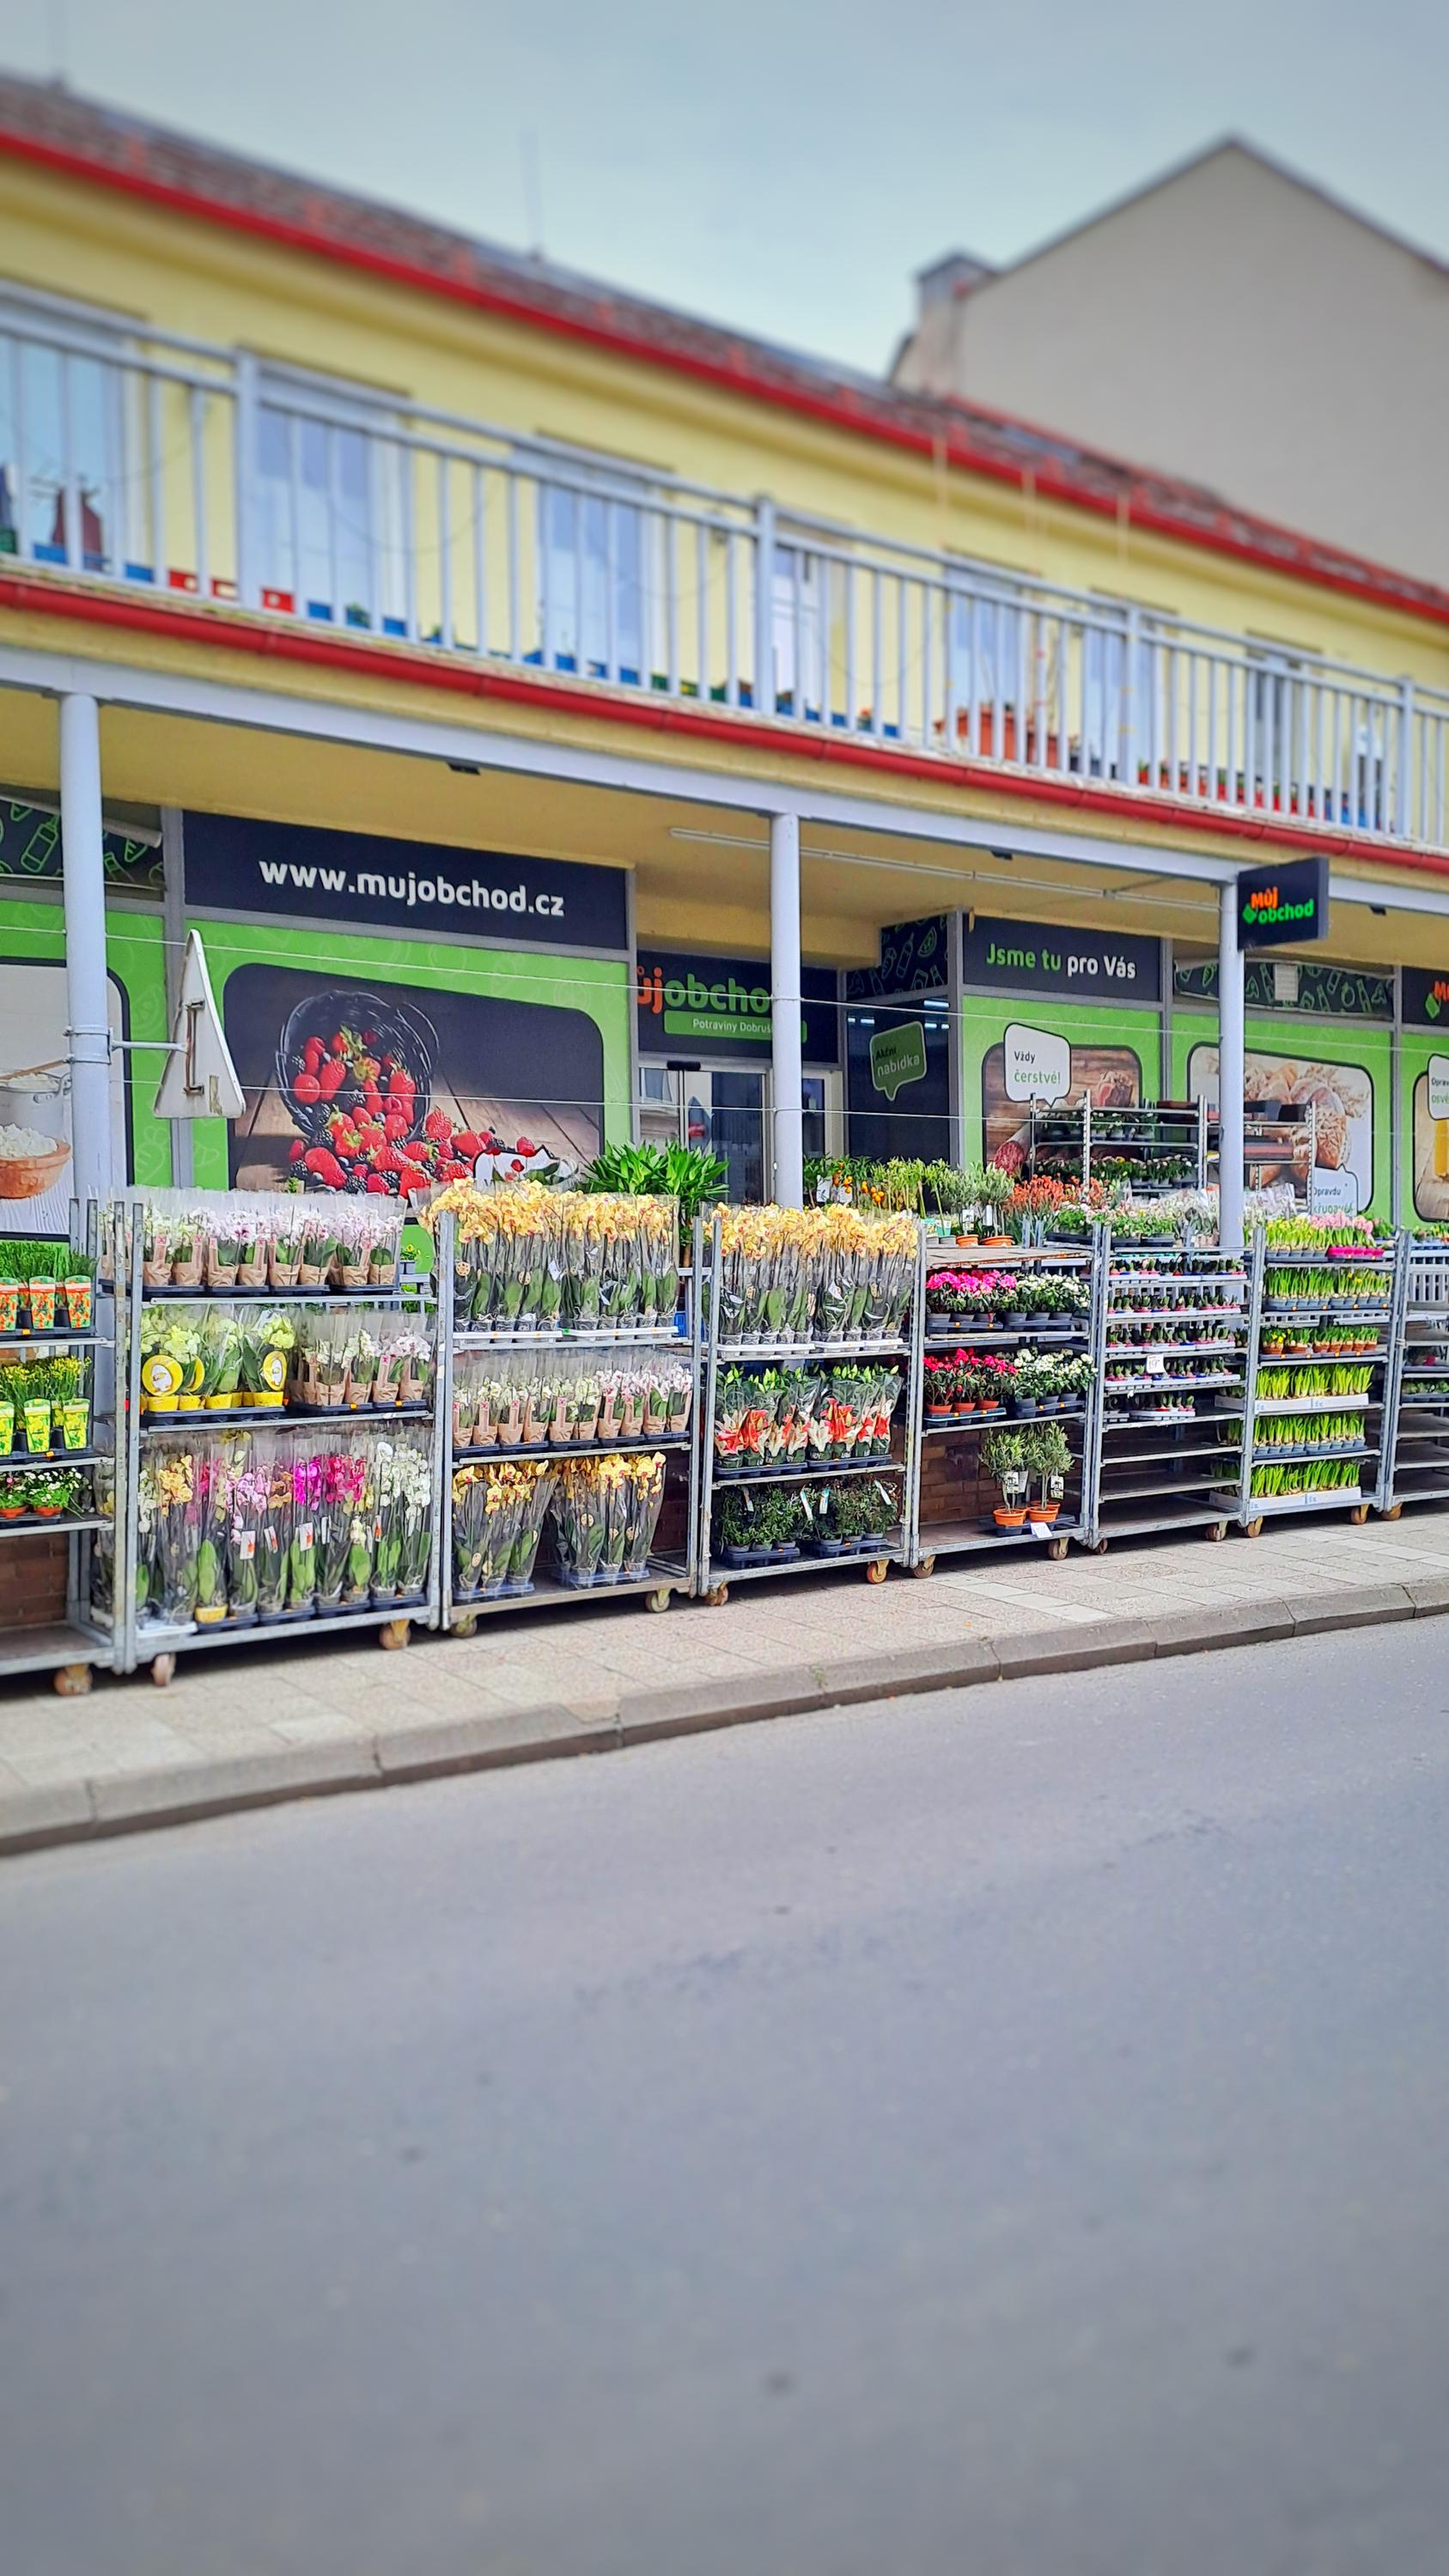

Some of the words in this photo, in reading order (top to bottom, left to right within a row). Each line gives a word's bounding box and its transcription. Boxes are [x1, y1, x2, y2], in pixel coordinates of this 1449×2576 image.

[259, 860, 564, 916] www.mujobchod.cz
[1258, 898, 1314, 924] obchod
[986, 943, 1036, 969] Jsme
[1041, 949, 1062, 970] tu
[1067, 956, 1099, 977] pro
[1104, 956, 1135, 978] Vás
[693, 1018, 737, 1032] Potraviny
[1014, 1050, 1036, 1064] Vždy
